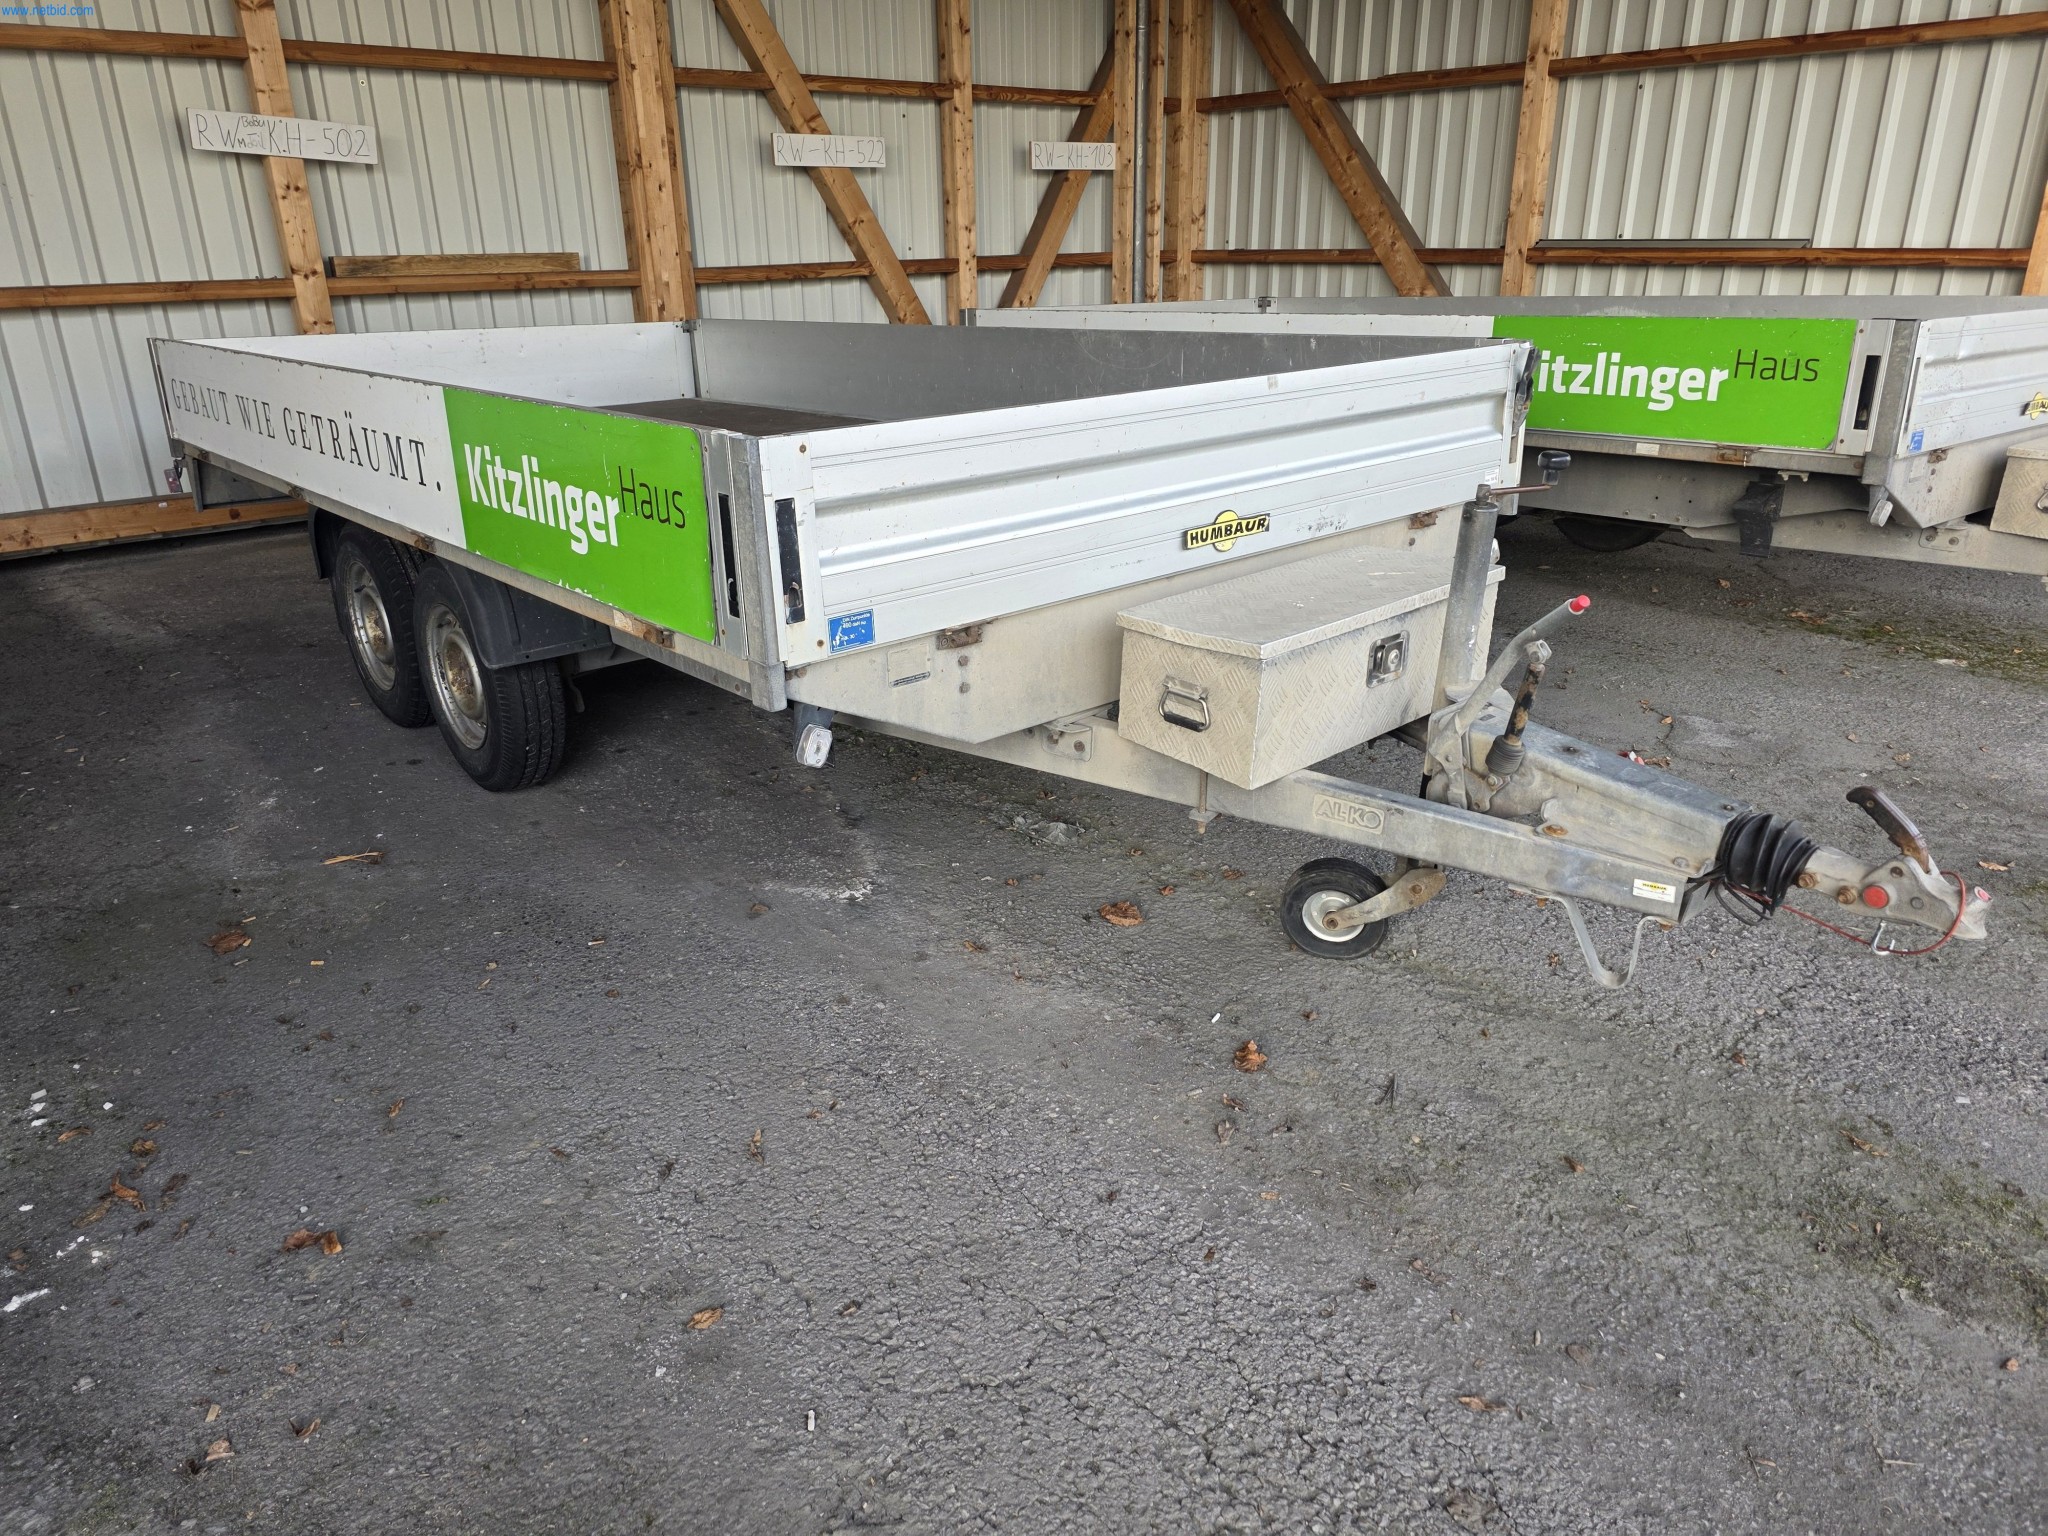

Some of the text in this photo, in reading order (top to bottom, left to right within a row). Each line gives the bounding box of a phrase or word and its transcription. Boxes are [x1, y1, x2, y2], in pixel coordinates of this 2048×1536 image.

[1536, 348, 1821, 412] itzlinger Haus
[170, 377, 442, 493] GEBAUT WIE GETRÄUMT.
[463, 443, 686, 555] Kitzlinger Haus
[1189, 516, 1267, 546] HUMBAUR
[1315, 799, 1382, 830] AL-KO
